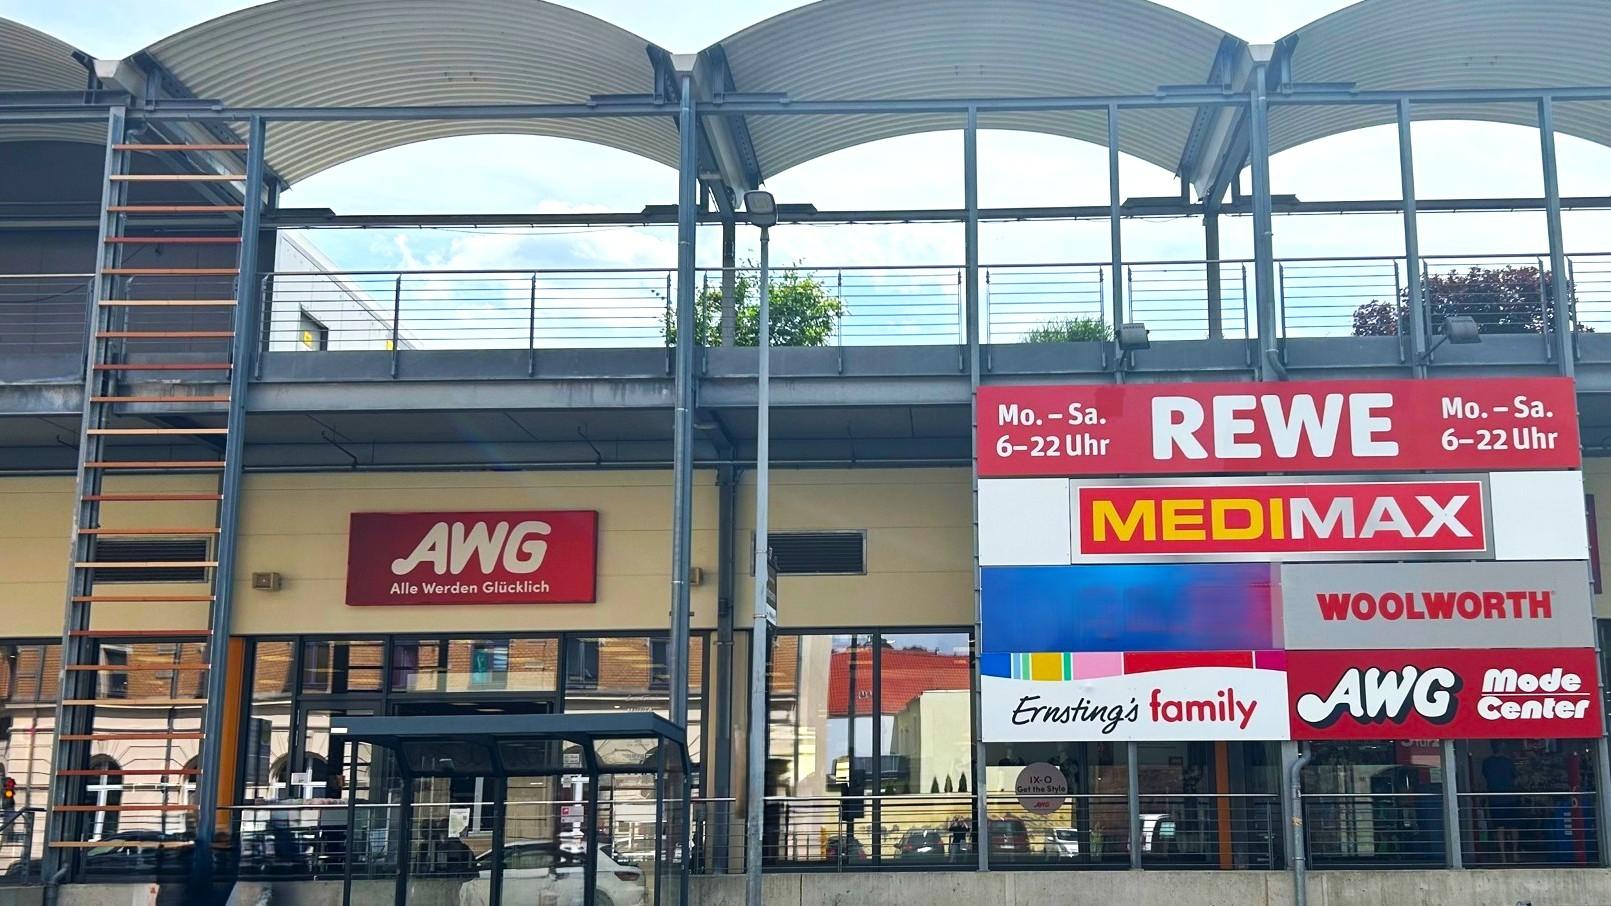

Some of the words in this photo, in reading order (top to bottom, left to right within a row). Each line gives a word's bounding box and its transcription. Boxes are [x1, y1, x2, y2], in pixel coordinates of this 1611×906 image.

[998, 403, 1043, 426] Mo.
[1068, 402, 1107, 426] Sa.
[1441, 396, 1489, 420] Mo.
[1513, 395, 1554, 419] Sa.
[1151, 392, 1400, 460] REWE
[1441, 428, 1509, 452] 6–22
[1512, 426, 1559, 450] Uhr
[996, 434, 1061, 458] 6–22
[1065, 432, 1110, 457] Uhr
[1092, 495, 1474, 542] MEDIMAX
[391, 521, 552, 576] AWG
[390, 582, 418, 595] Alle
[422, 582, 478, 594] Werden
[483, 580, 550, 594] Glücklich
[1316, 591, 1553, 621] WOOLWORTH
[1297, 665, 1457, 723] AWG
[1482, 667, 1582, 694] Mode
[1149, 687, 1258, 730] family
[1477, 694, 1590, 721] Center
[1047, 784, 1066, 792] Style
